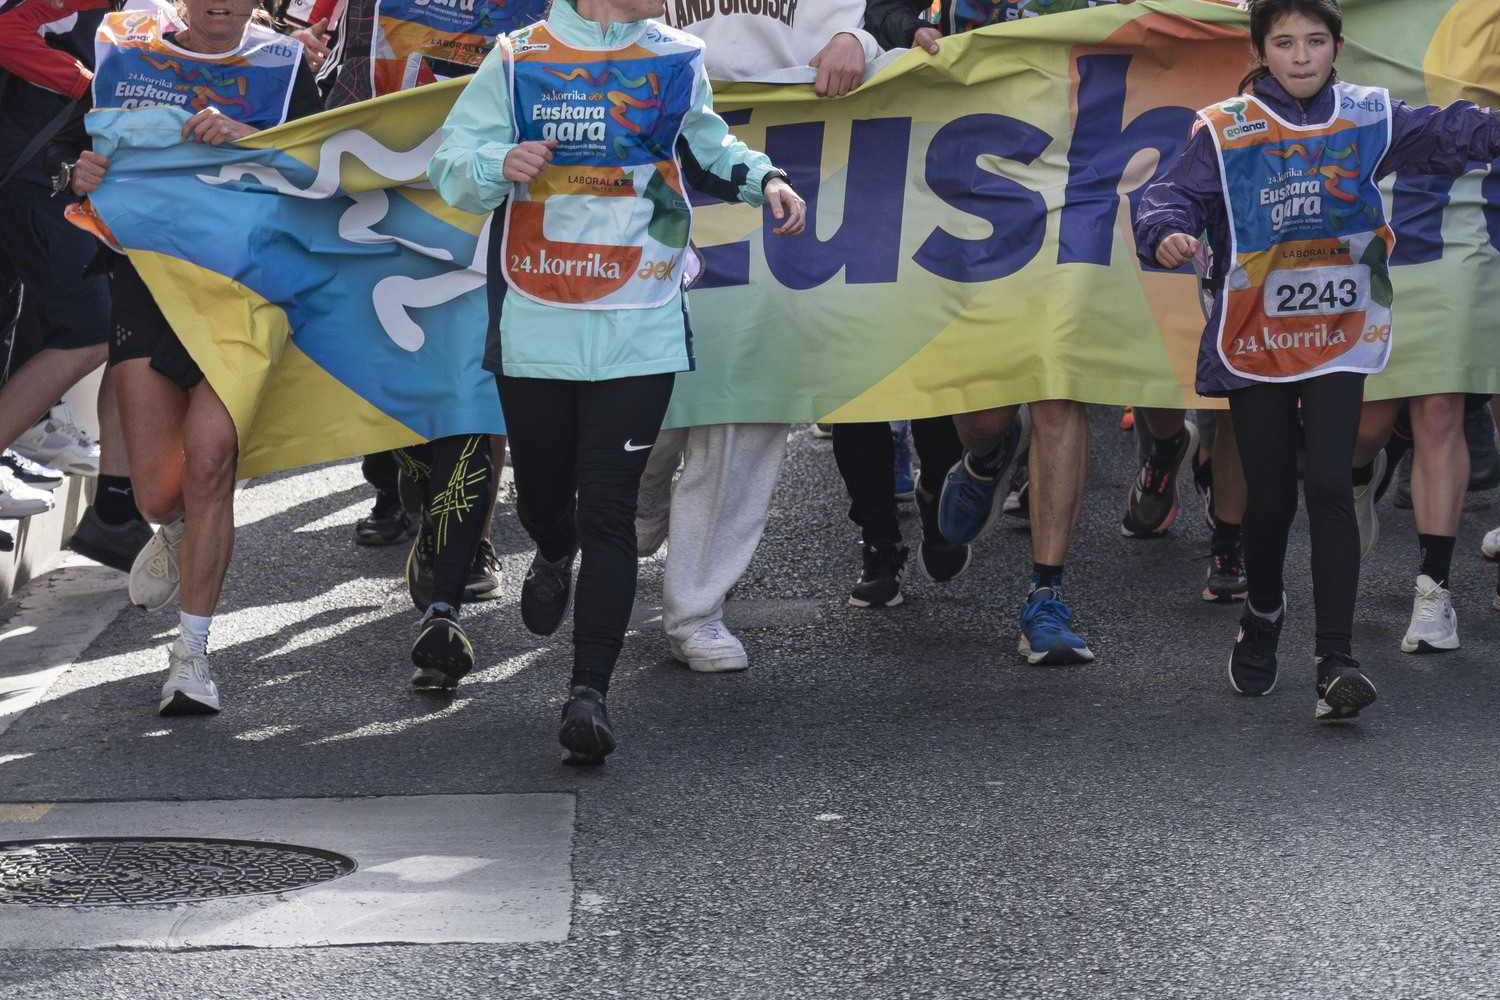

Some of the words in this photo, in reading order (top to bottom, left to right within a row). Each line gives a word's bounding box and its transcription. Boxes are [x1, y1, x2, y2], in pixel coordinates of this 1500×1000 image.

[431, 38, 473, 52] LABORAL
[128, 73, 172, 89] 24.korrika
[115, 81, 188, 104] Euskara
[541, 90, 587, 101] 24.korrika
[532, 102, 605, 121] Euskara
[1357, 97, 1385, 113] eitb
[568, 175, 612, 187] LABORAL
[1283, 248, 1328, 259] LABORAL
[511, 249, 621, 280] 24.korrika
[638, 254, 676, 282] aek
[1277, 279, 1358, 312] 2243
[1234, 324, 1347, 356] 24.korrika
